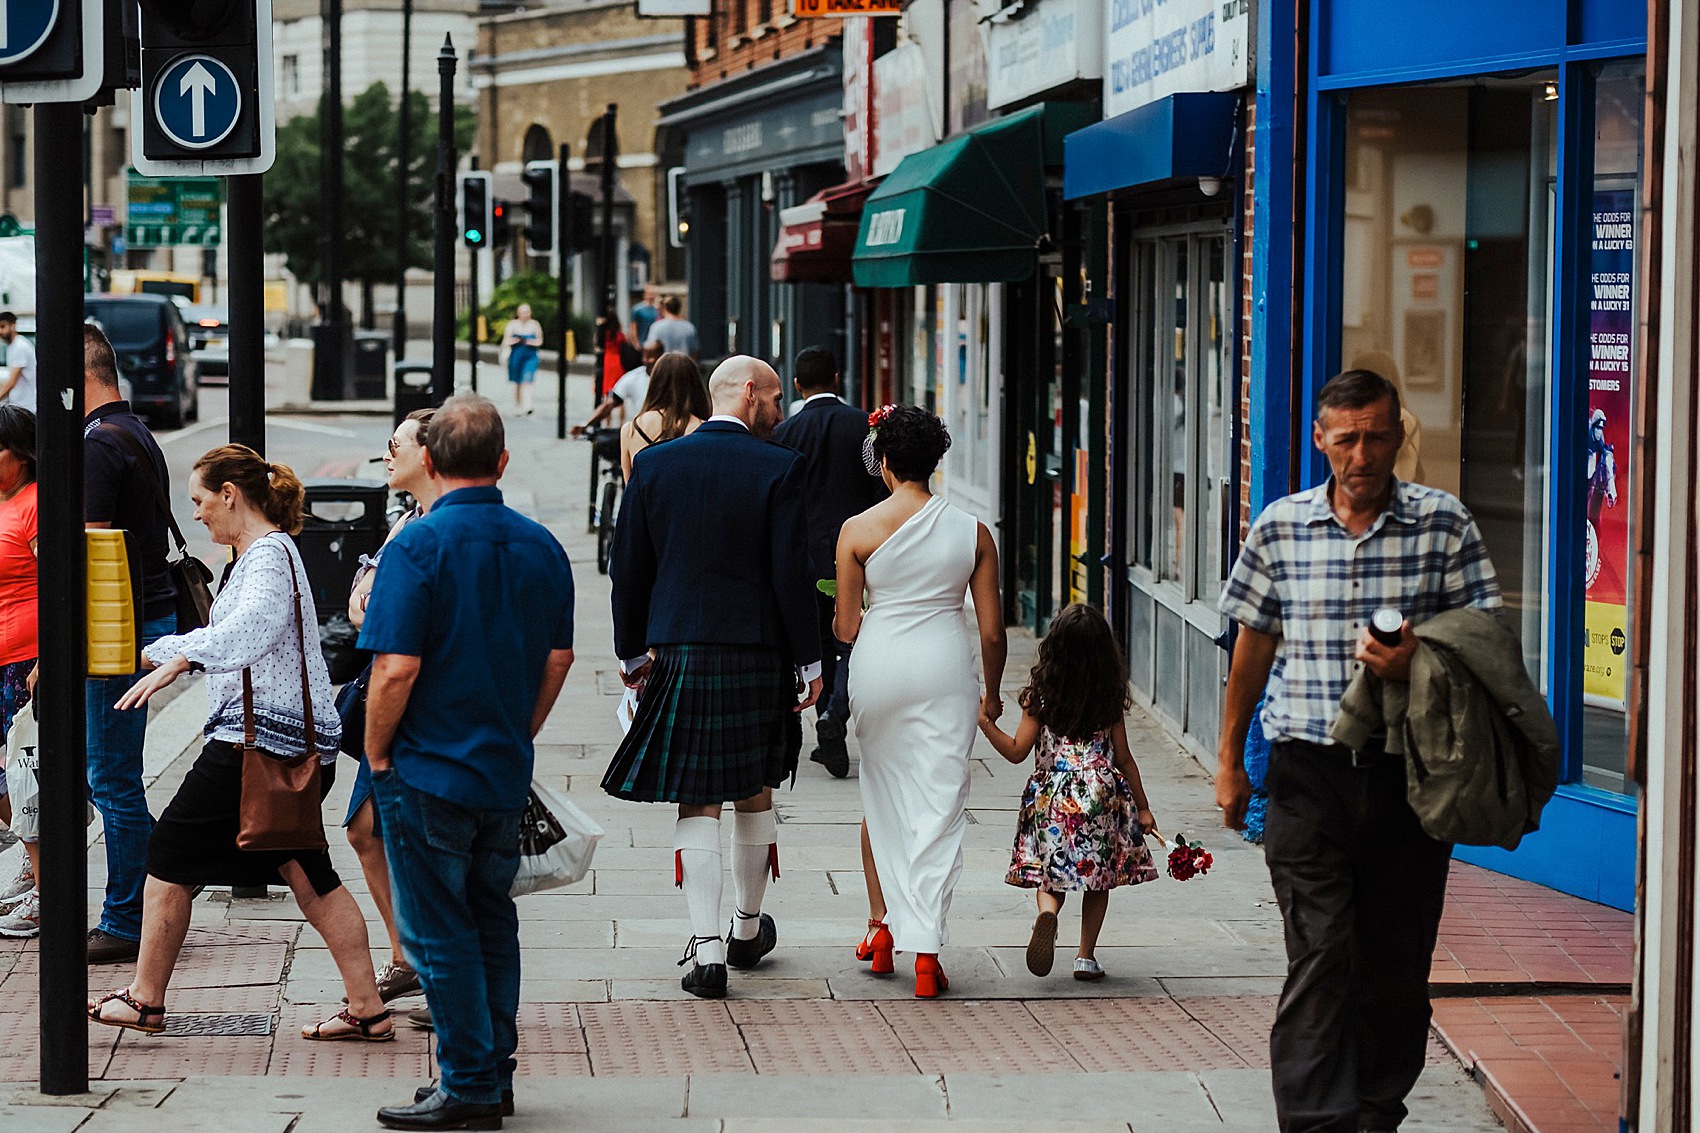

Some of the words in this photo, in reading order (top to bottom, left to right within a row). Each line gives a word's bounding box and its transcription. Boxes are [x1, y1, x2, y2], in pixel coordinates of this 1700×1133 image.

[1603, 212, 1619, 222] ODDS
[1620, 212, 1631, 222] FOR
[1596, 224, 1632, 238] WINNER
[1599, 240, 1604, 250] A
[1604, 240, 1624, 250] LUCKY
[1600, 273, 1616, 283] ODDS
[1617, 273, 1630, 283] FOR
[1594, 285, 1630, 299] WINNER
[1598, 301, 1602, 310] A
[1604, 301, 1622, 310] LUCKY
[1622, 301, 1630, 310] 31
[1599, 334, 1616, 343] ODDS
[1616, 334, 1628, 344] FOR
[1592, 345, 1629, 360] WINNER
[1595, 361, 1600, 370] A
[1600, 361, 1620, 371] LUCKY
[1622, 362, 1628, 372] 15
[1592, 633, 1609, 646] STOPS
[1611, 635, 1624, 648] STOP
